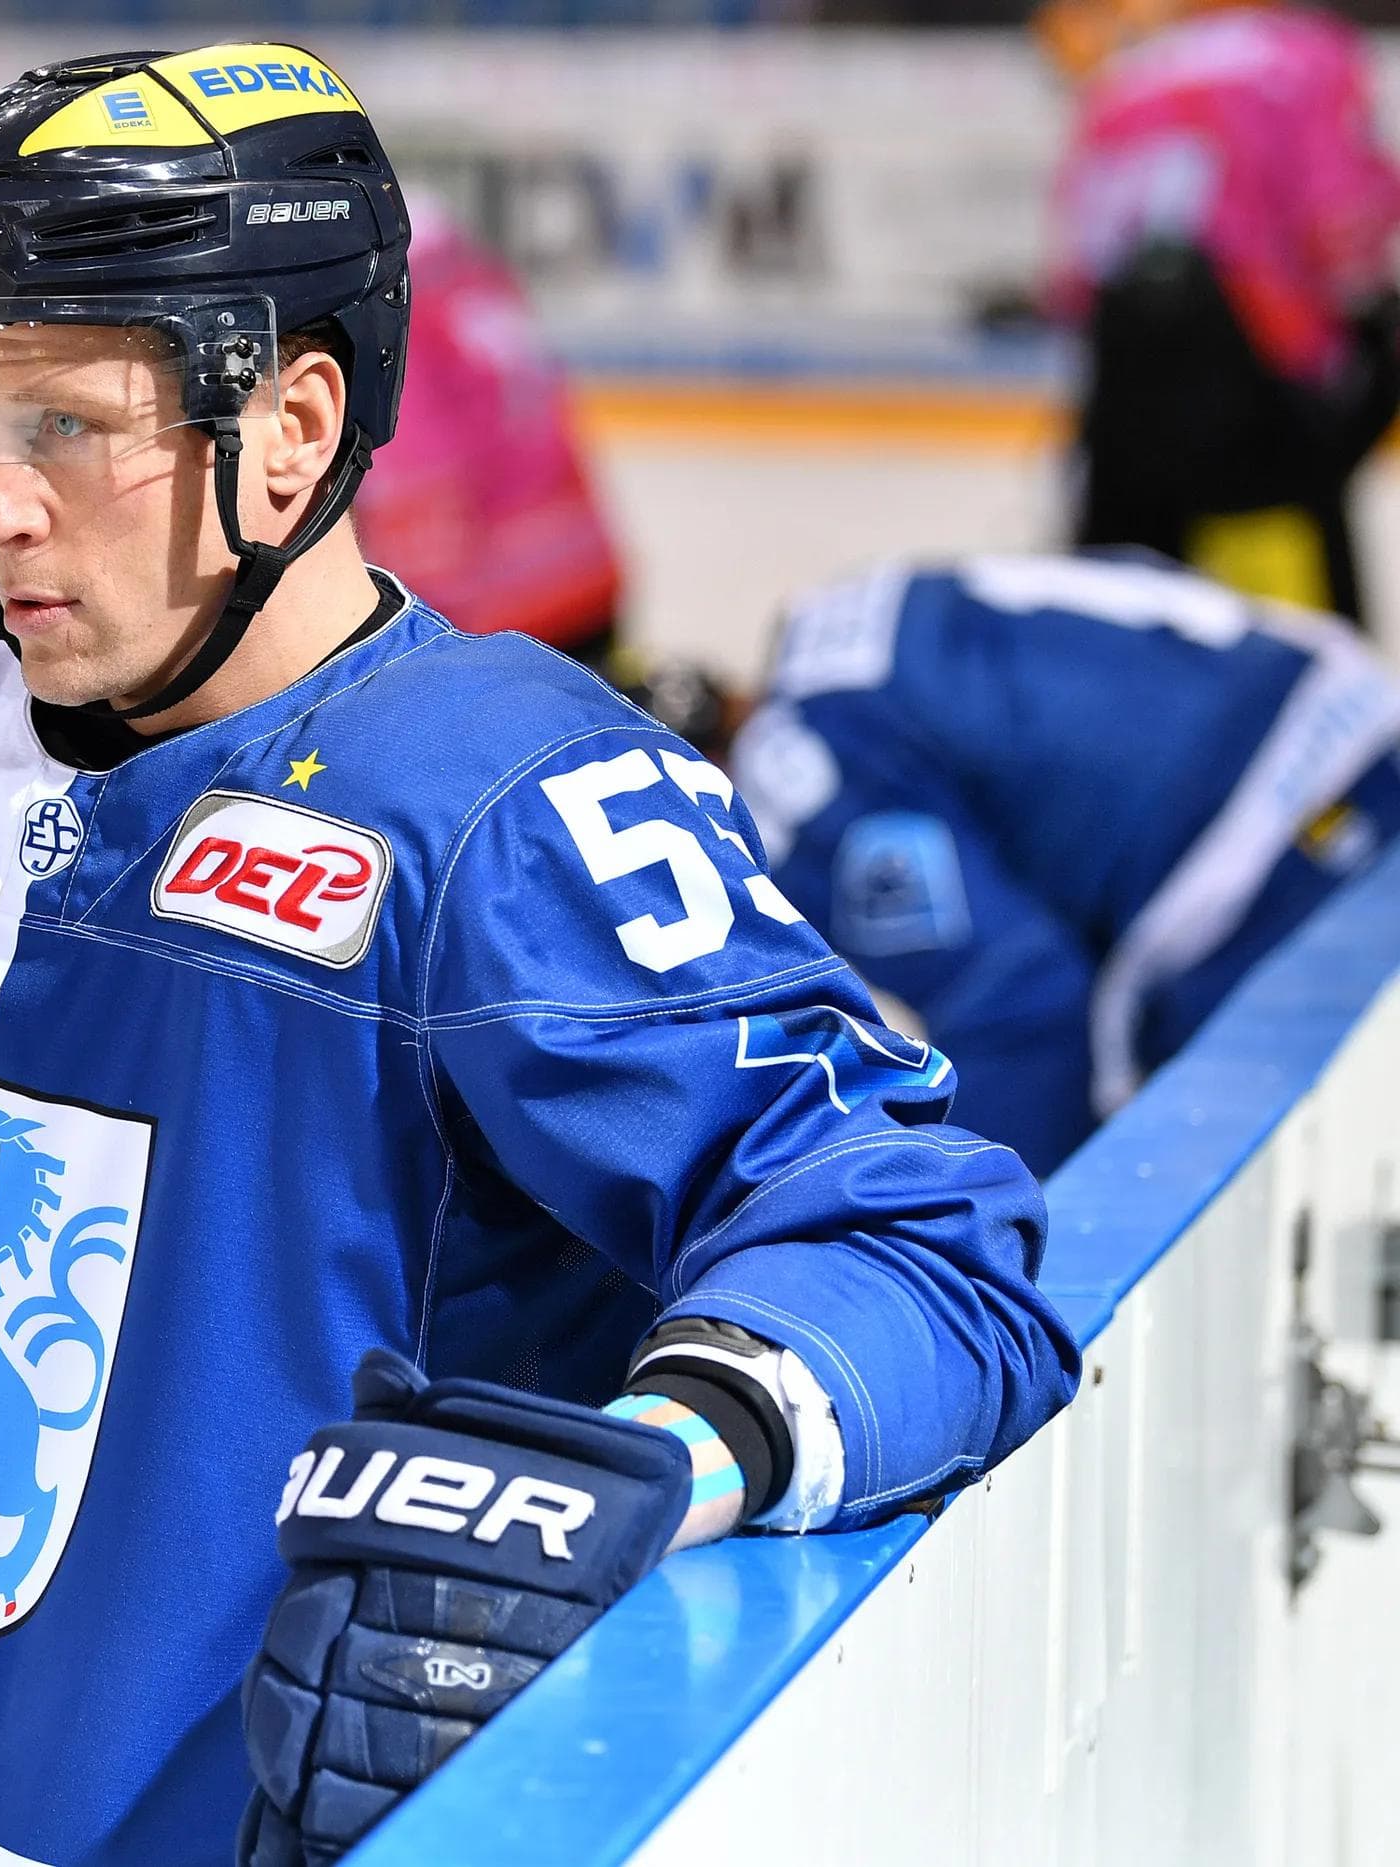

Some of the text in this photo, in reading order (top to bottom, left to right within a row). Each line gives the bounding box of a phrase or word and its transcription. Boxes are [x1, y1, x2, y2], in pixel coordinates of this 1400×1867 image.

[189, 63, 349, 102] EDEKA
[102, 91, 148, 121] E
[113, 119, 152, 130] EDEKA
[165, 836, 329, 933] DEL
